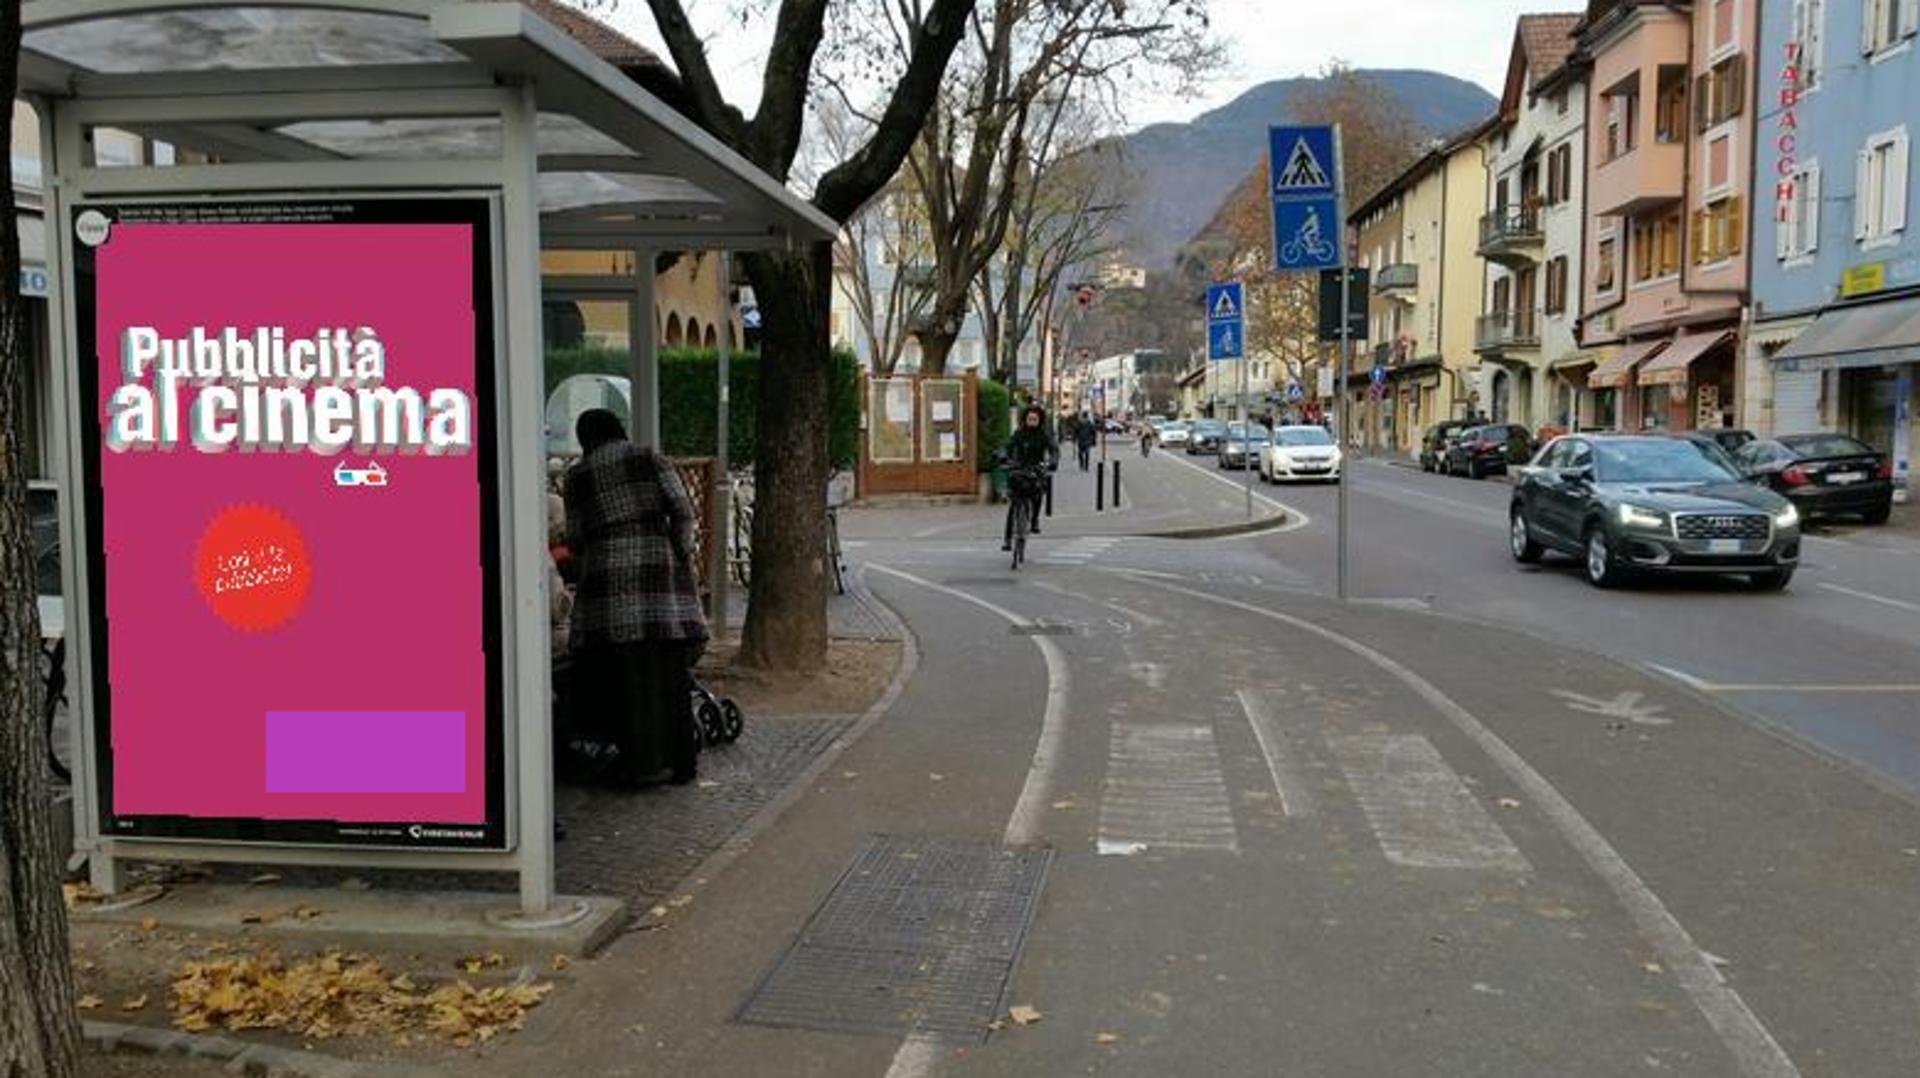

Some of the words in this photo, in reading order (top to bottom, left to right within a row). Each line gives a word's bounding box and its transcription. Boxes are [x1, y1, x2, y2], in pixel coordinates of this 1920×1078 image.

[1776, 43, 1799, 222] TABACCHI
[124, 326, 386, 381] Pubblicità
[111, 366, 179, 447] al
[194, 382, 472, 450] cinema
